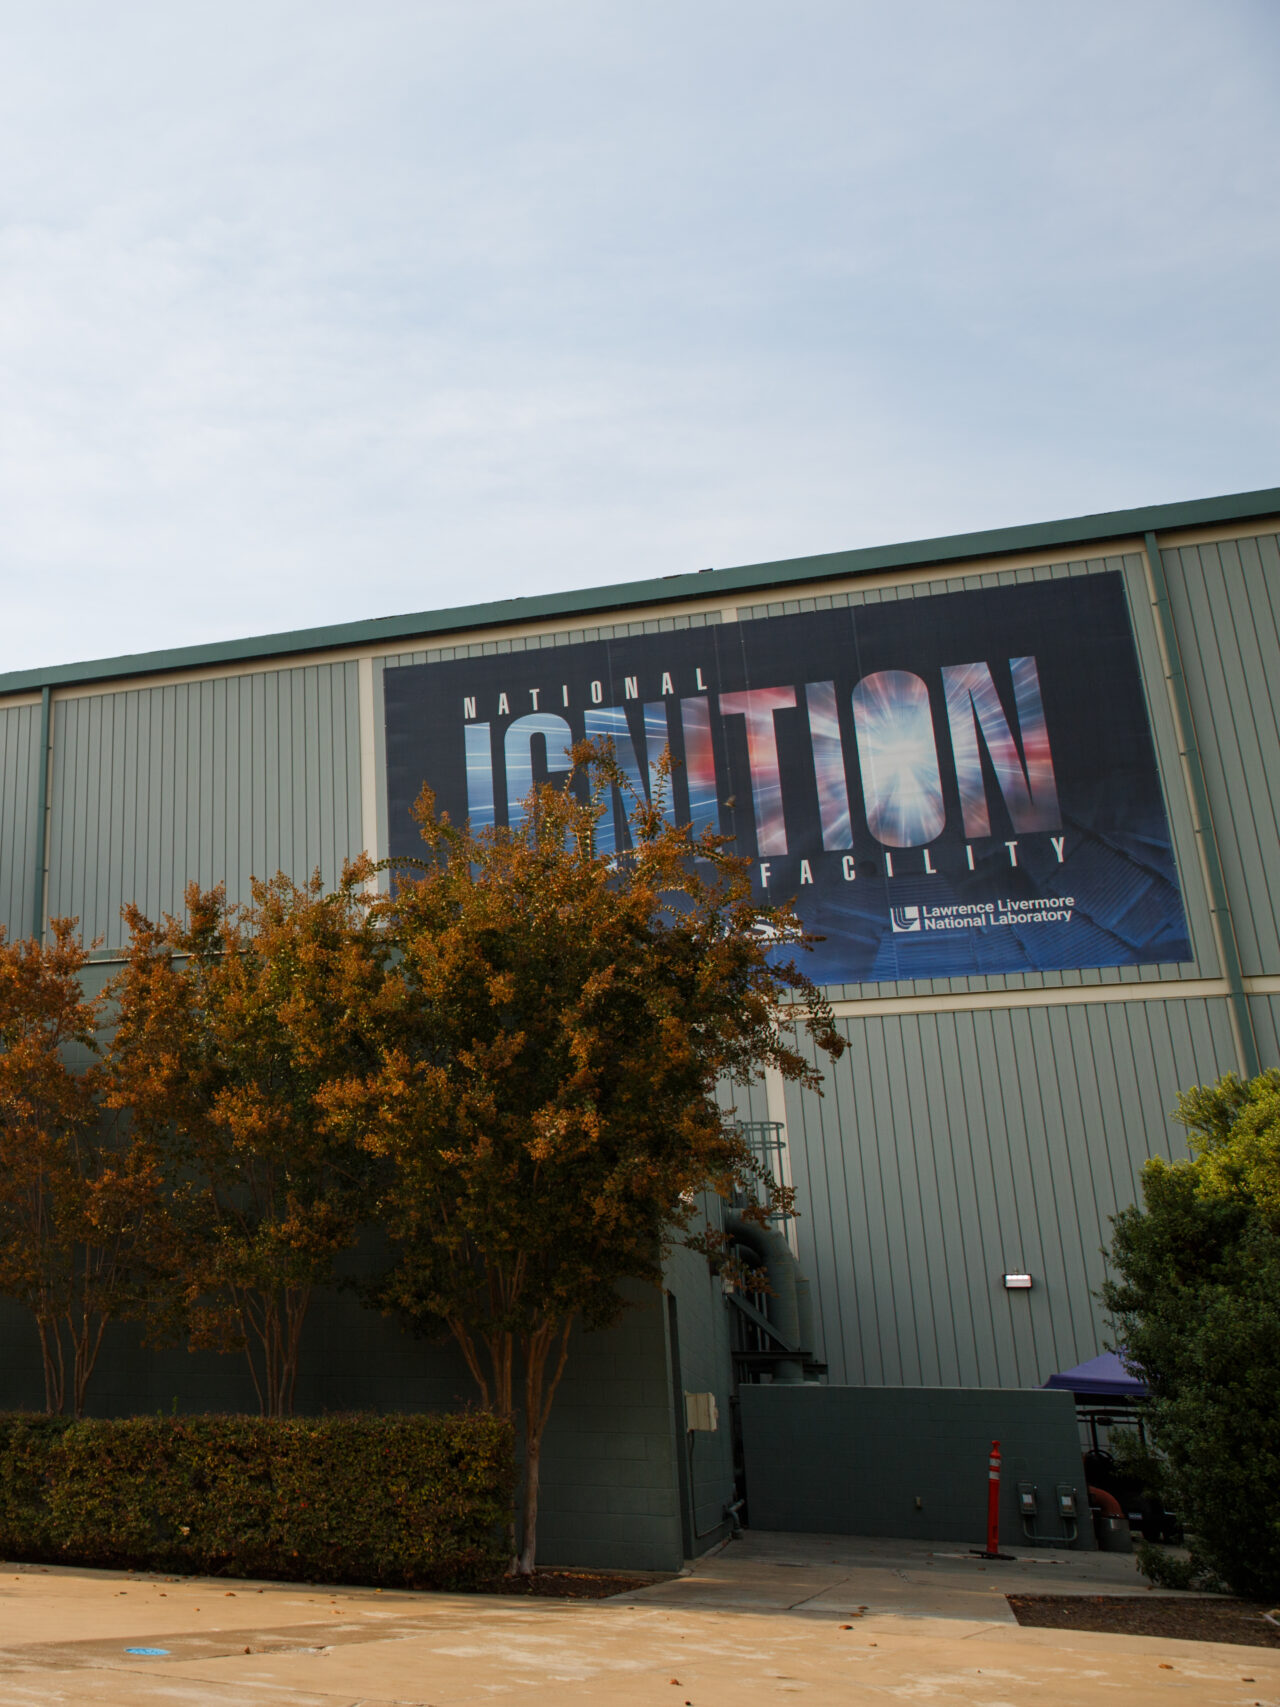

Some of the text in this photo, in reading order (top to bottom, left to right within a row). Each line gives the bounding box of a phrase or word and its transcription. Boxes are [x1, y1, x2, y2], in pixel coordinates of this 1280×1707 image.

[463, 667, 708, 720] NATIONAL
[760, 836, 1066, 889] FACILITY
[922, 896, 1076, 918] Lawrence Livermore
[924, 910, 1073, 930] National Laboratory
